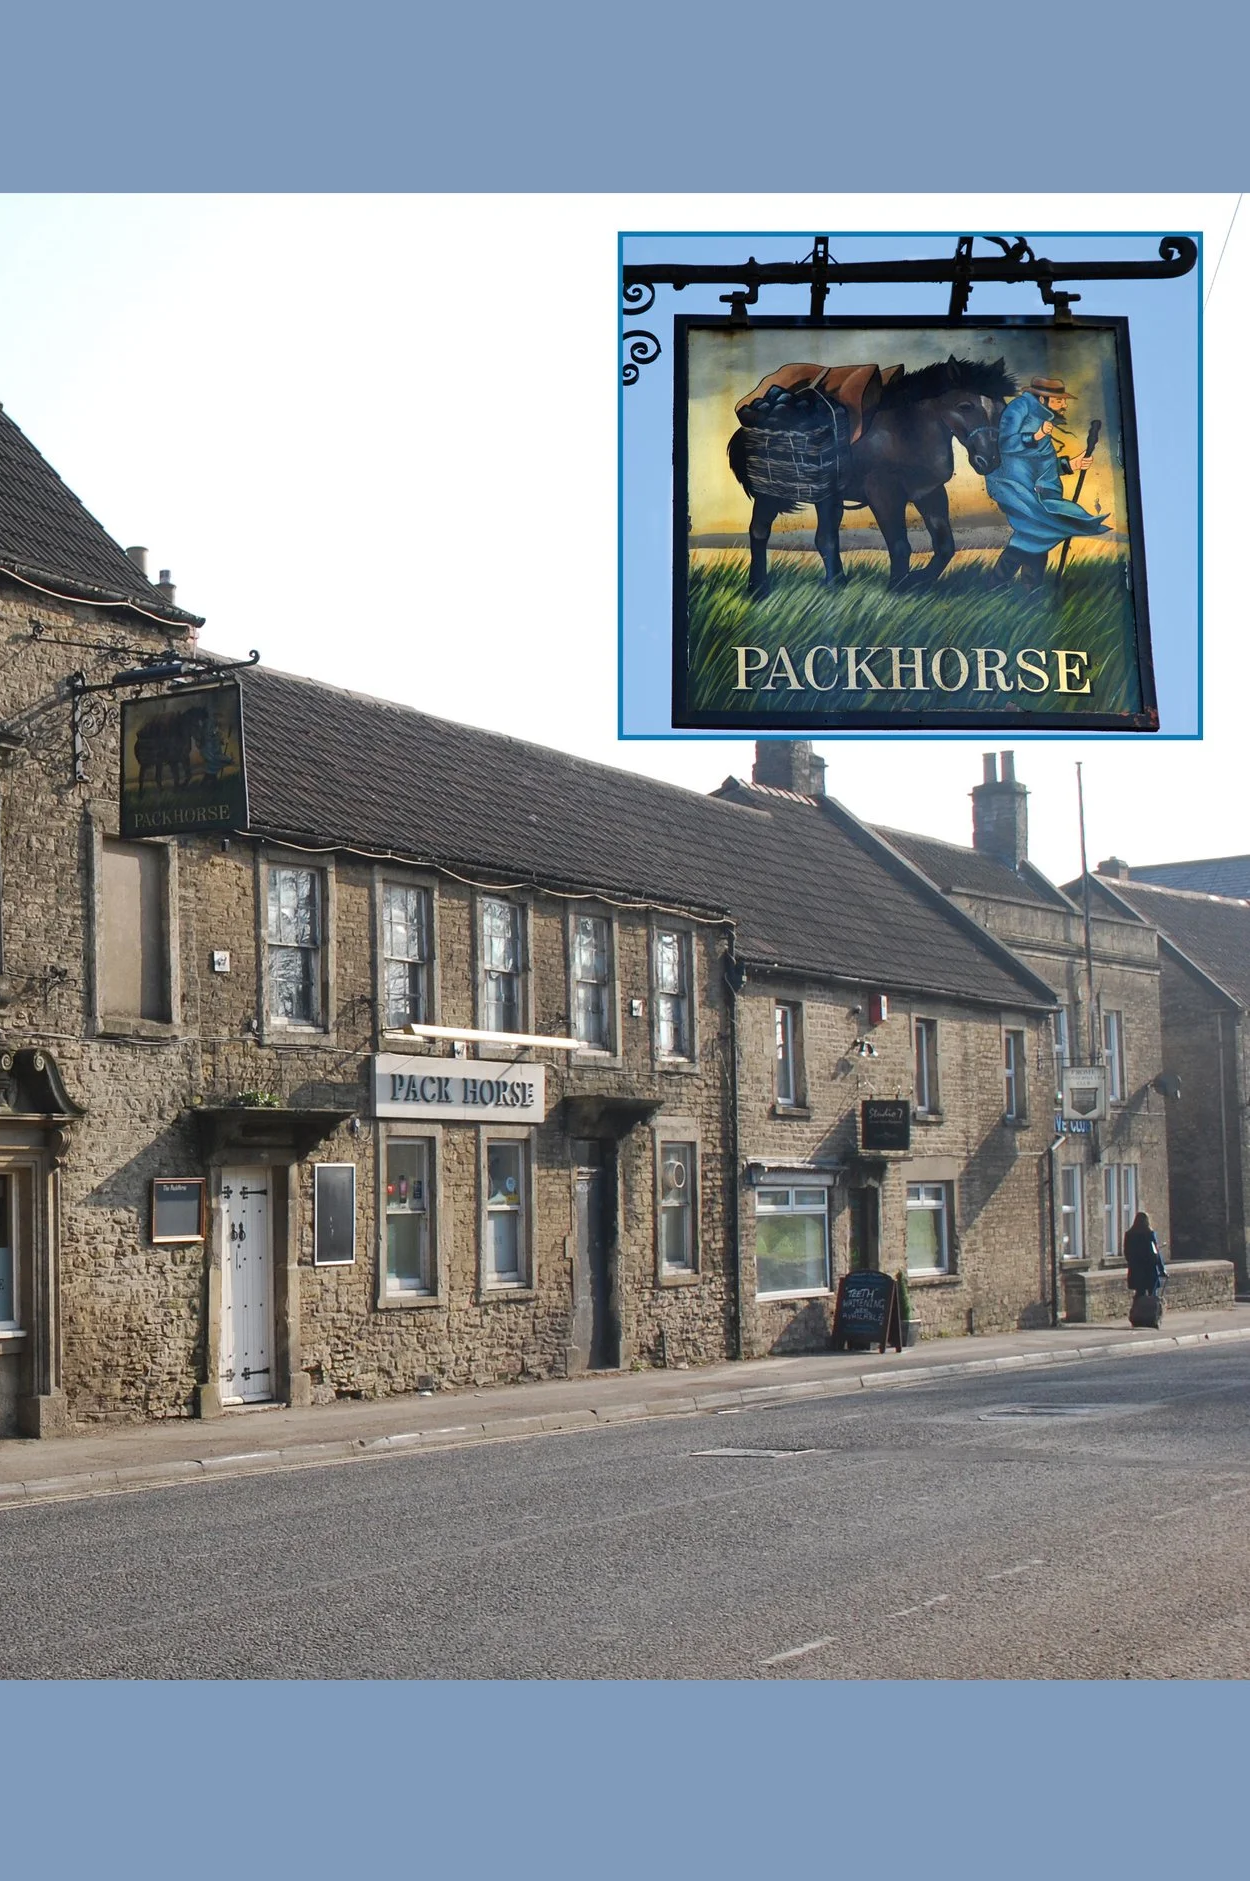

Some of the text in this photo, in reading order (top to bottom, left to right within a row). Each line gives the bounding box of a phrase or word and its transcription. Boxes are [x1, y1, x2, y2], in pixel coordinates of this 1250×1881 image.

[731, 645, 1092, 694] PACKHORSE
[134, 804, 231, 828] PACKHORSE
[390, 1073, 536, 1108] PACK HORSE
